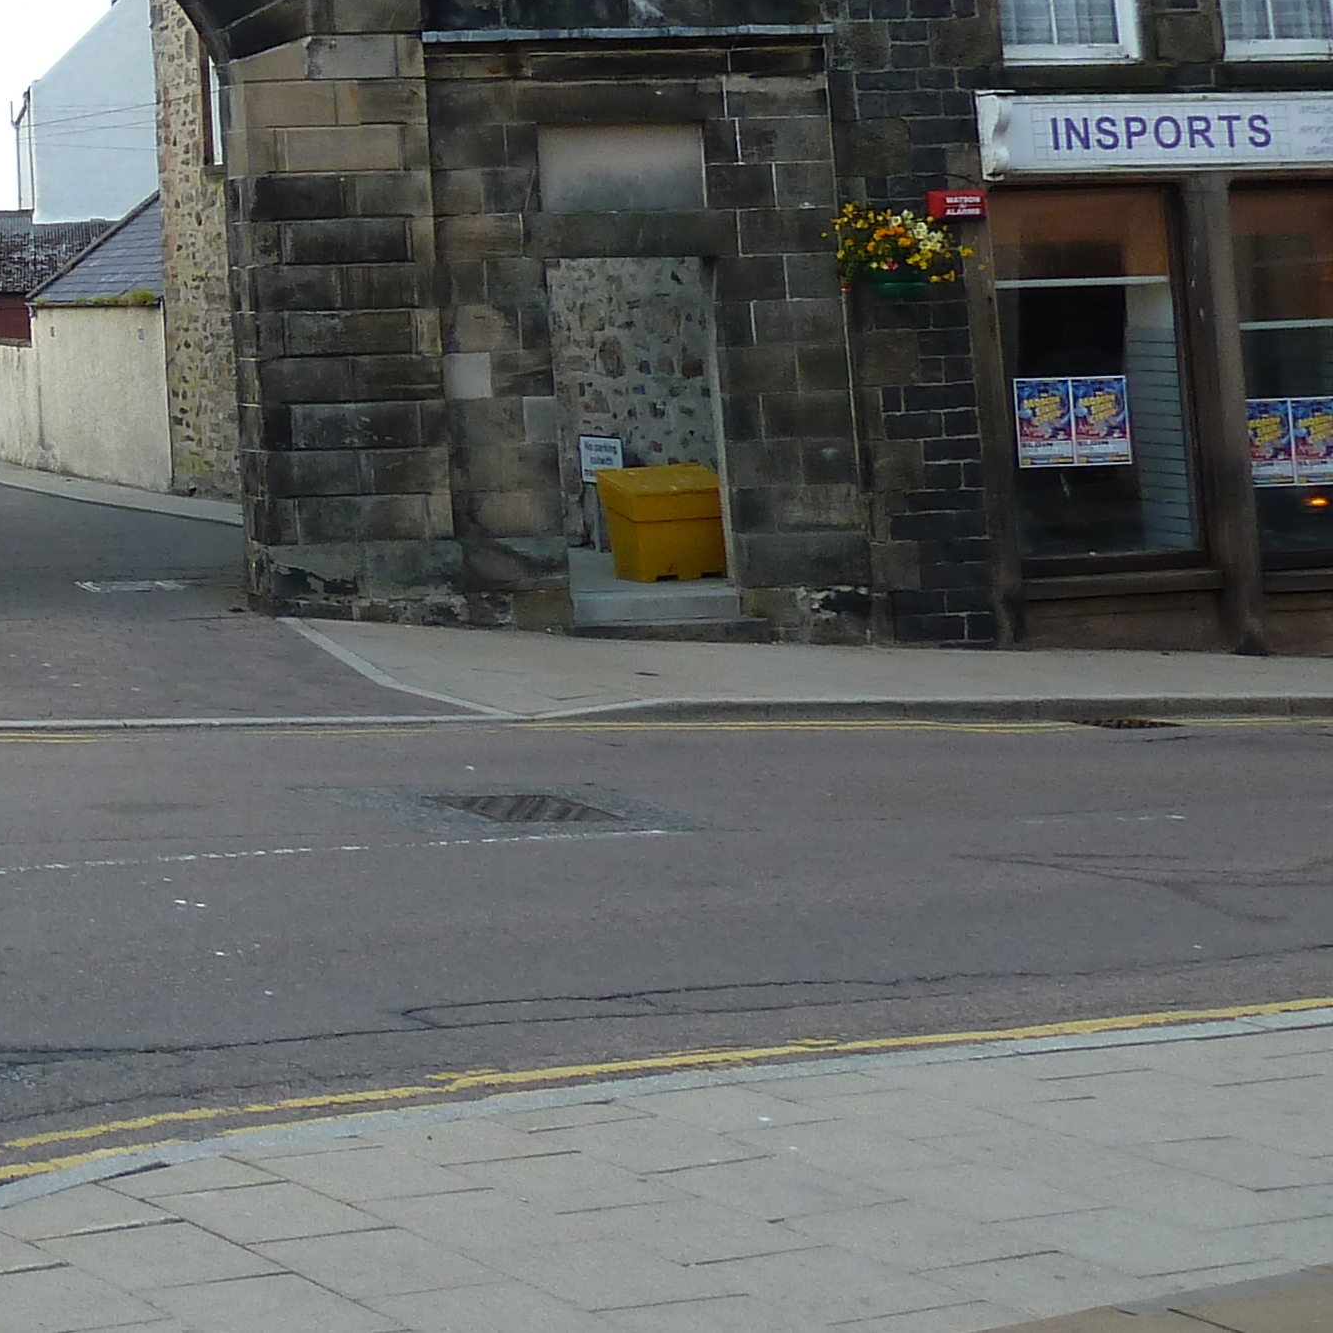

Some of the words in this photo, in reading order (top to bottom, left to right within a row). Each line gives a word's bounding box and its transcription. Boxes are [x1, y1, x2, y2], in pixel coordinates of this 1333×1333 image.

[1050, 114, 1272, 150] INSPORTS
[584, 441, 593, 451] No
[594, 442, 618, 455] parking
